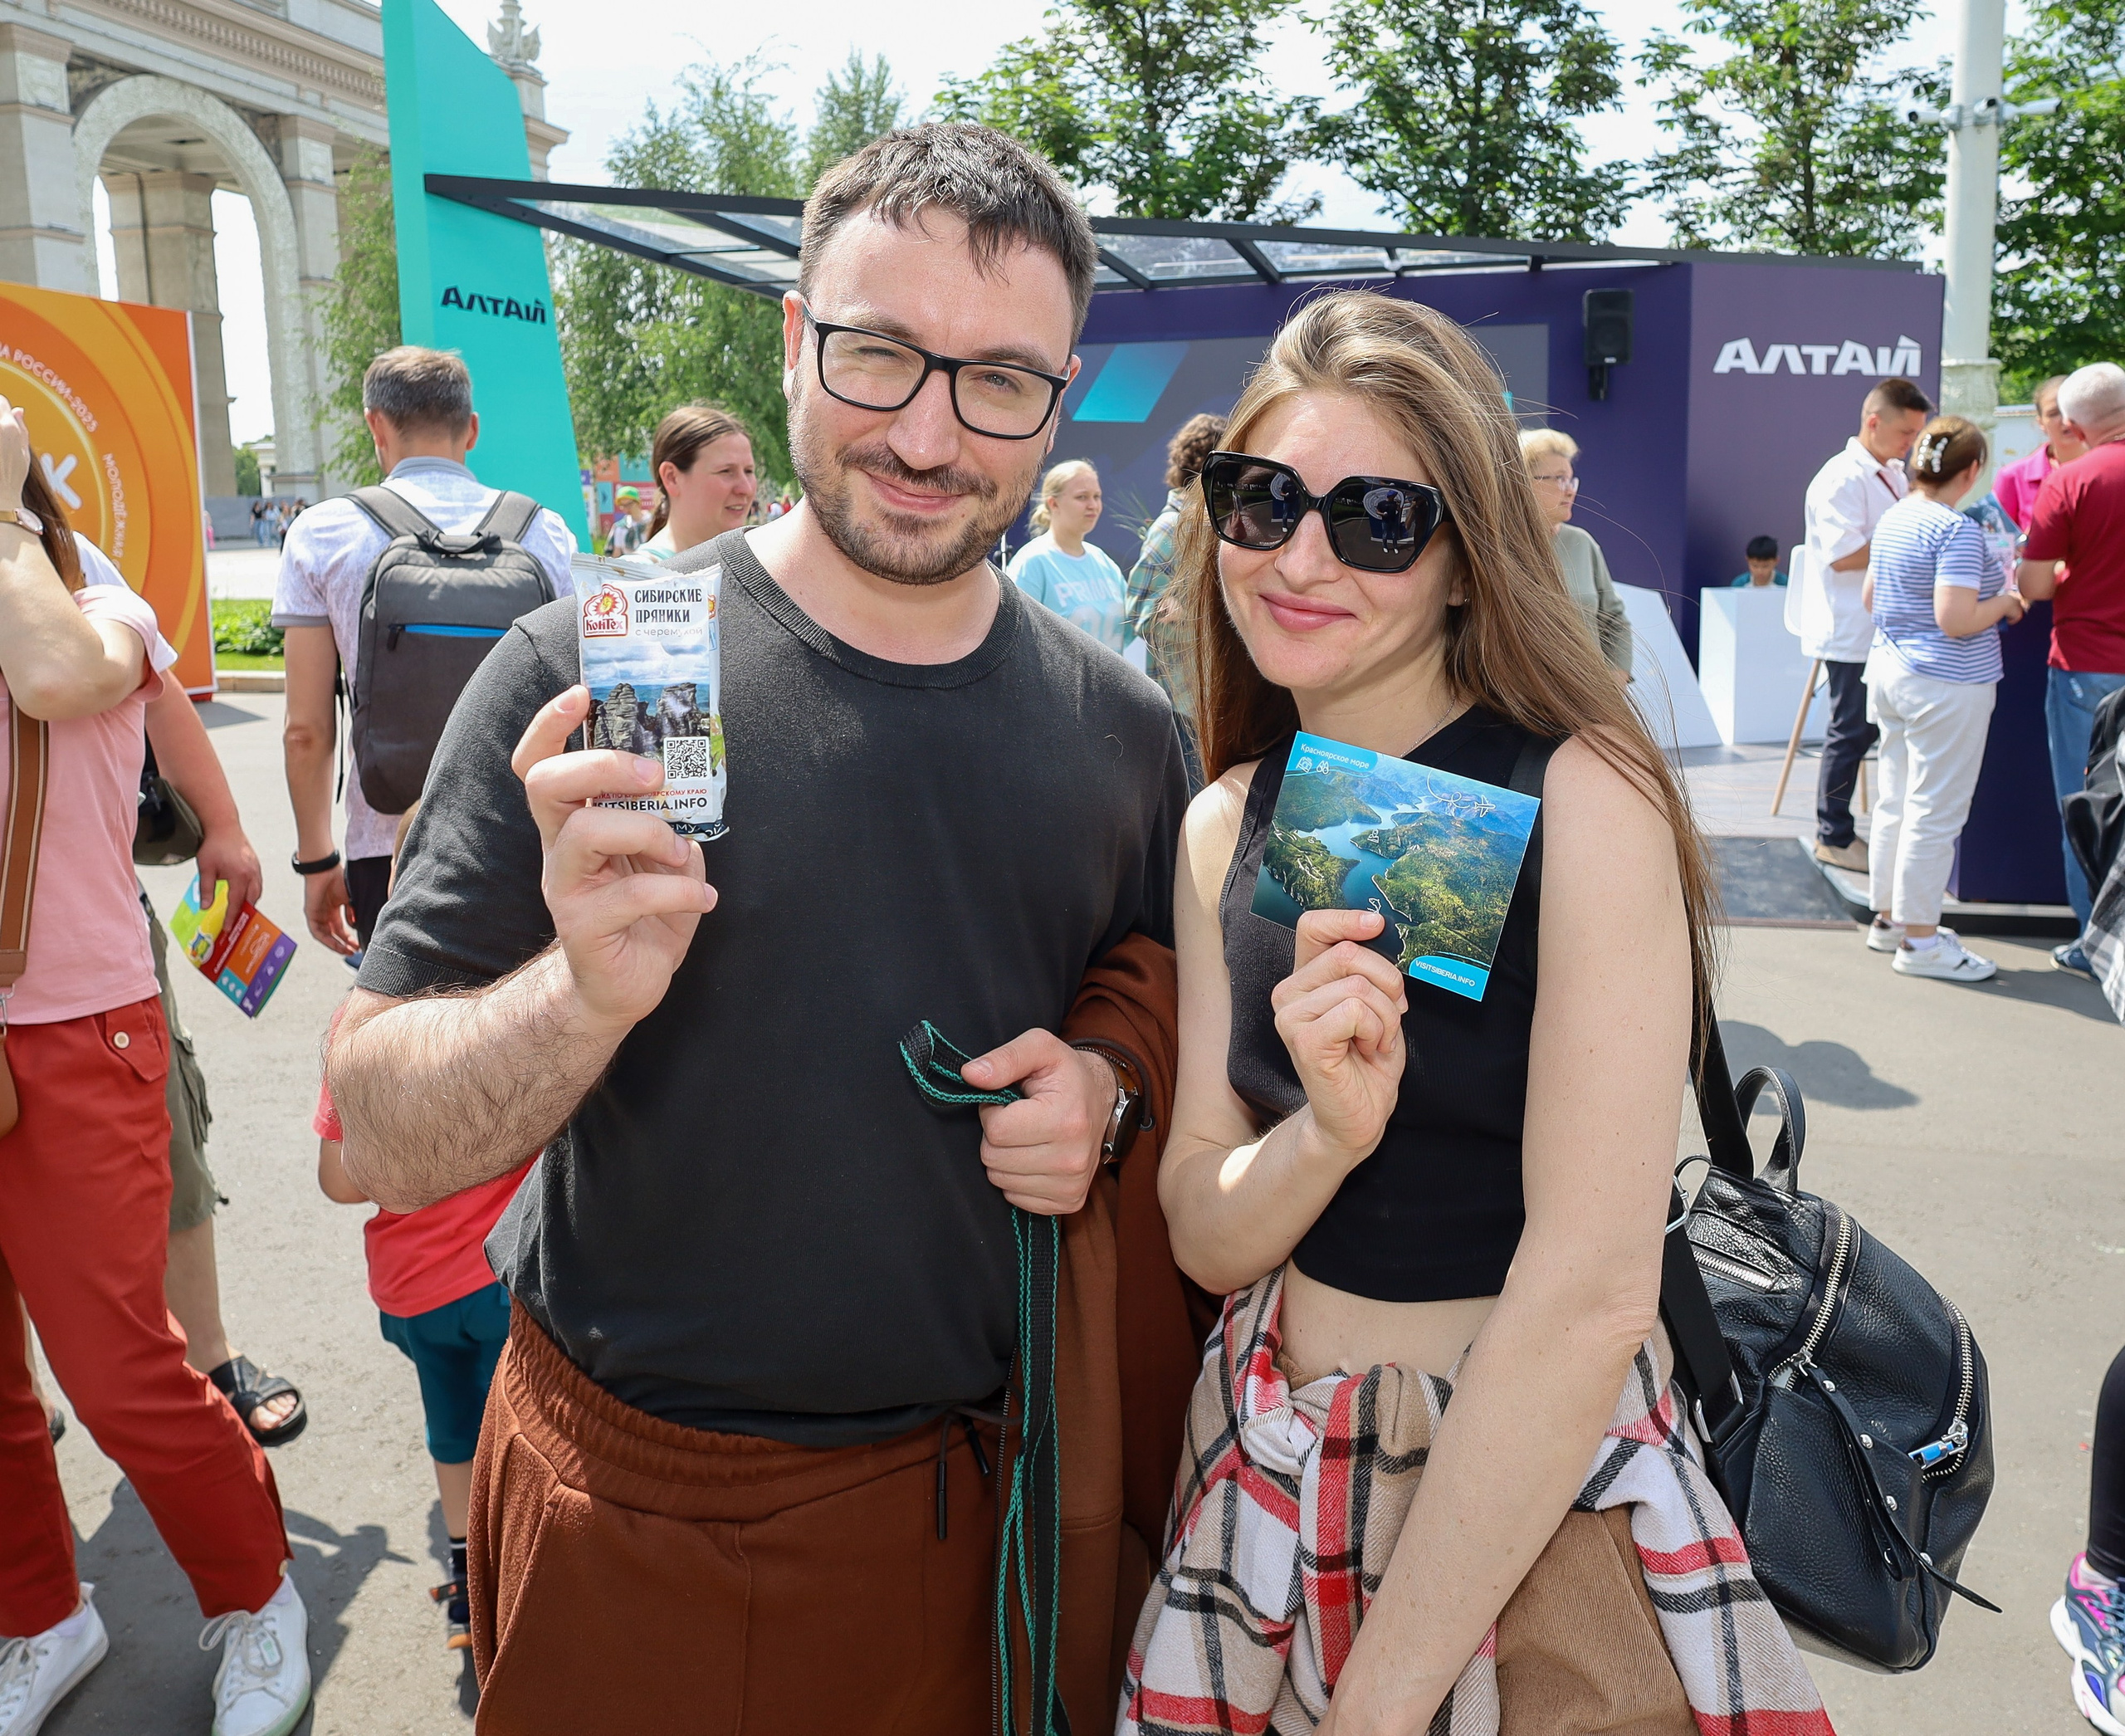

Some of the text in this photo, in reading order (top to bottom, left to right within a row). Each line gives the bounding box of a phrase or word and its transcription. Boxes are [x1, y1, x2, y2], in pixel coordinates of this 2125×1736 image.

[442, 286, 546, 324] АЛТАЙ
[1712, 335, 1922, 377] АЛТАЙ
[13, 348, 99, 433] РОССИИ-2025
[634, 588, 702, 604] СИБИРСКИЕ
[635, 609, 691, 623] ПРЯНИКИ
[643, 627, 703, 638] черемухой
[1300, 743, 1370, 770] Красноярское море
[1414, 960, 1477, 987] VISITSIBERIA.INFO
